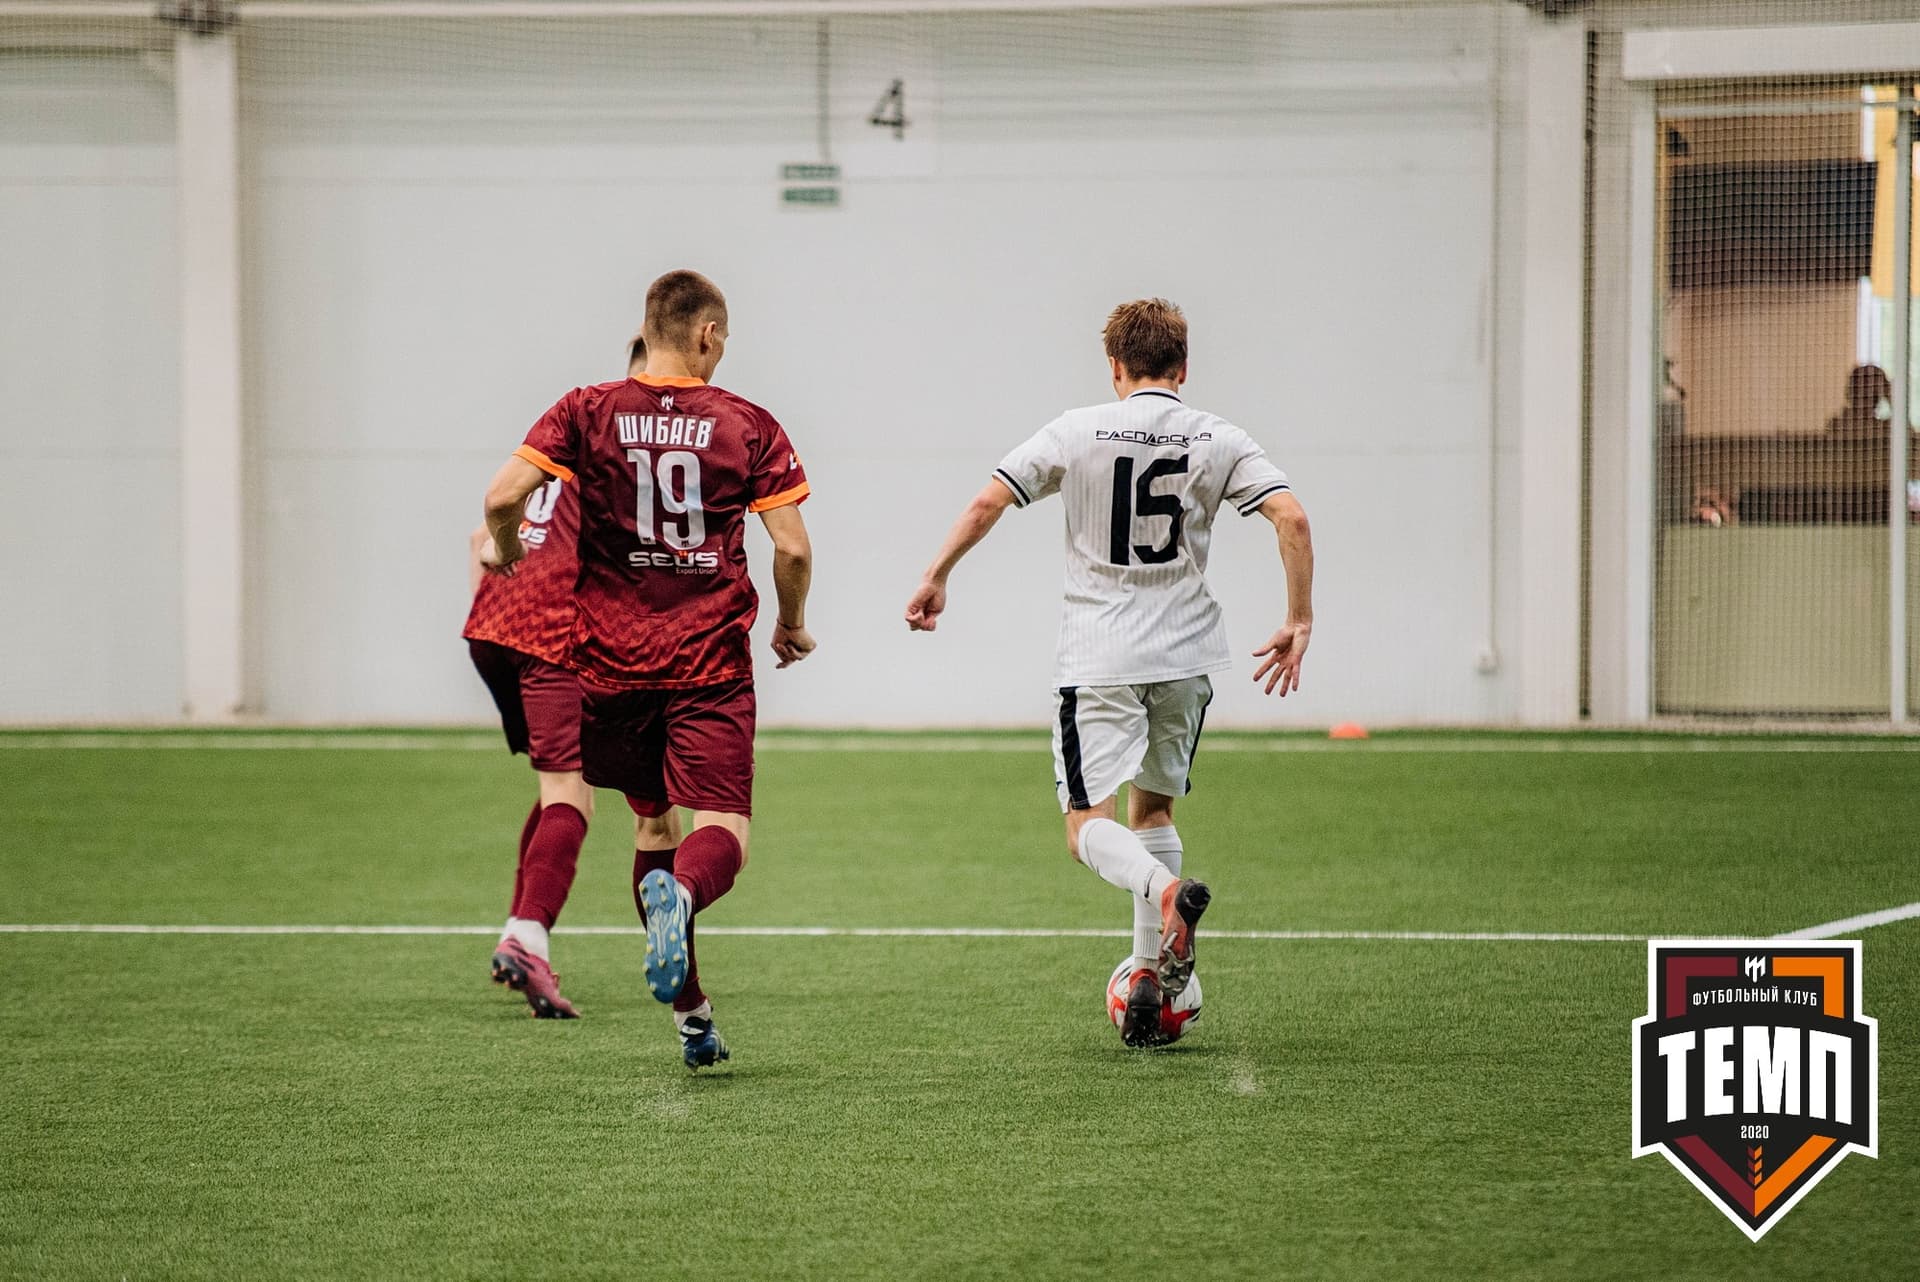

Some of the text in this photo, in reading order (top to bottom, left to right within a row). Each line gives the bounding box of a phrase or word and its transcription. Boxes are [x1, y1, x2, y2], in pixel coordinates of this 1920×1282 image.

[868, 78, 910, 140] 4
[617, 413, 713, 447] ШИБАЕВ
[1096, 430, 1212, 448] РАСПАДСКЯ
[627, 449, 707, 550] 19
[1110, 454, 1189, 566] 15
[628, 551, 719, 568] SEUS
[676, 567, 718, 576] Export Union
